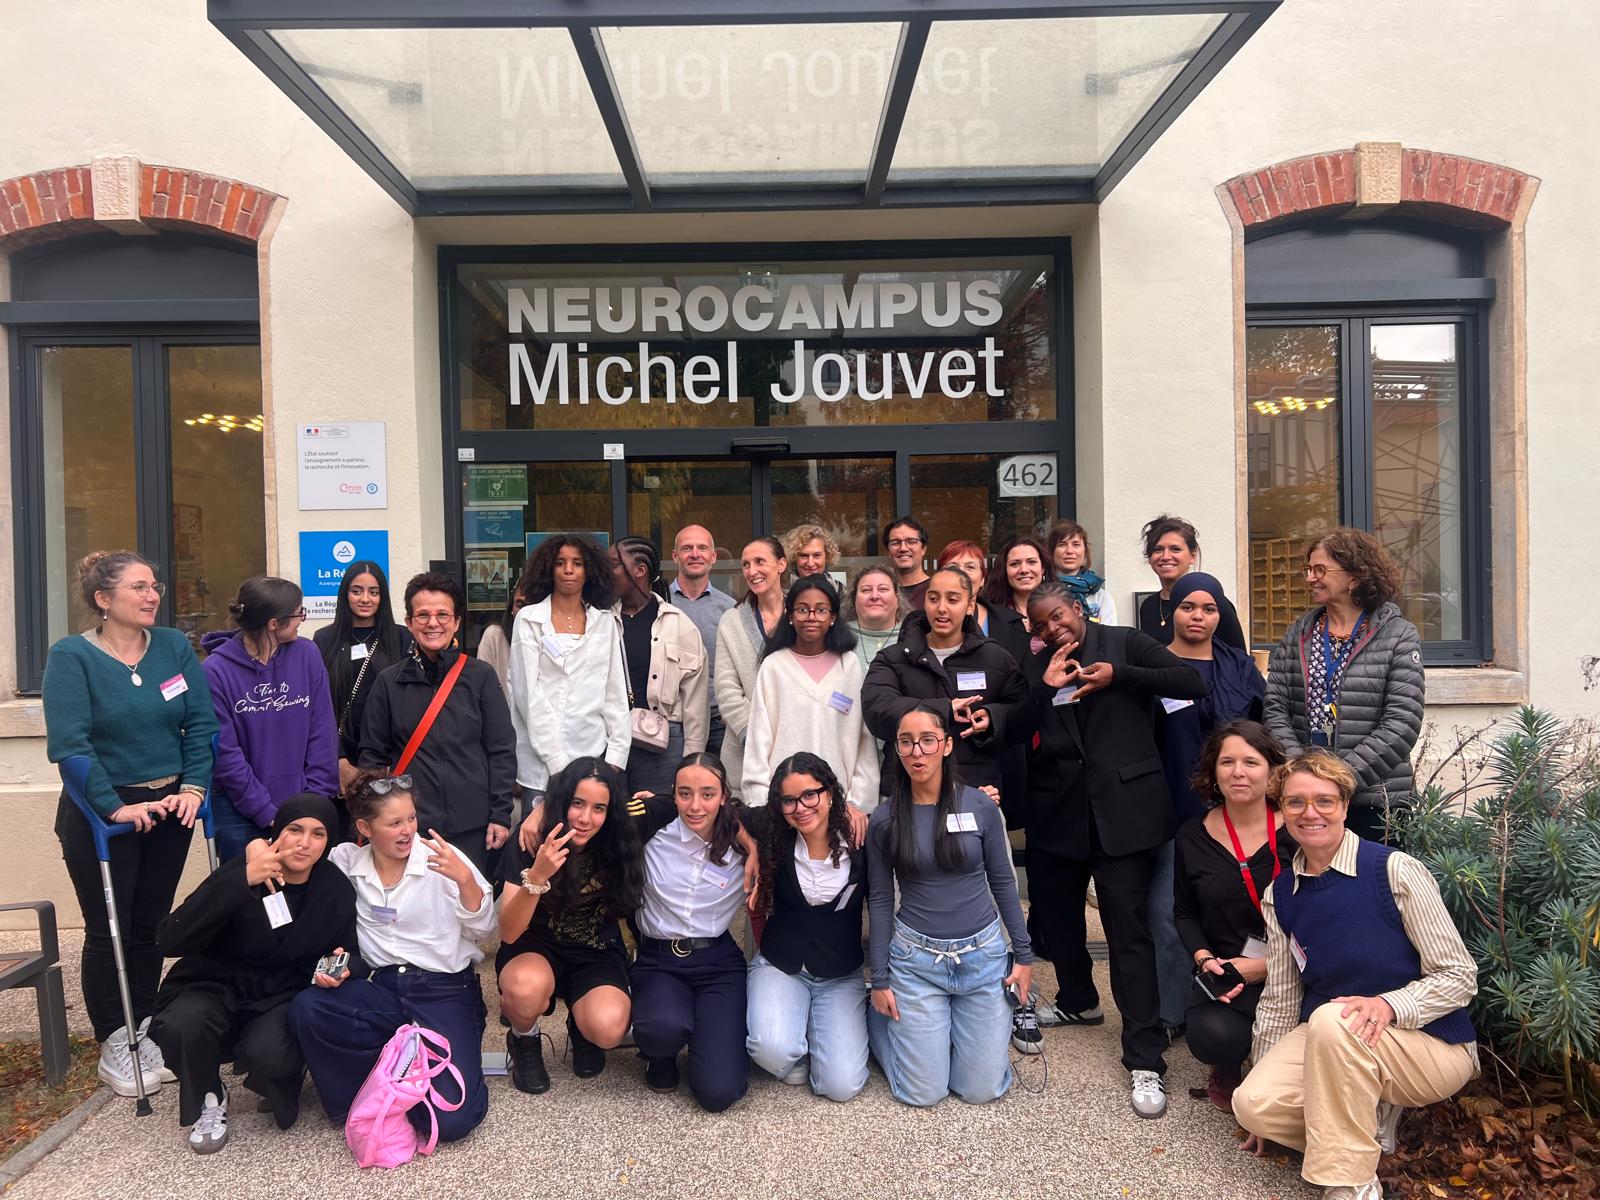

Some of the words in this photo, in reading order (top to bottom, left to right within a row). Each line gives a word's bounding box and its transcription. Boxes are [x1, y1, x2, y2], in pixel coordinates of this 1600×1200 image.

[507, 279, 1003, 333] NEUROCAMPUS
[508, 341, 738, 406] Michel
[770, 336, 1005, 404] Jouvet
[1003, 462, 1054, 487] 462
[318, 569, 331, 578] La
